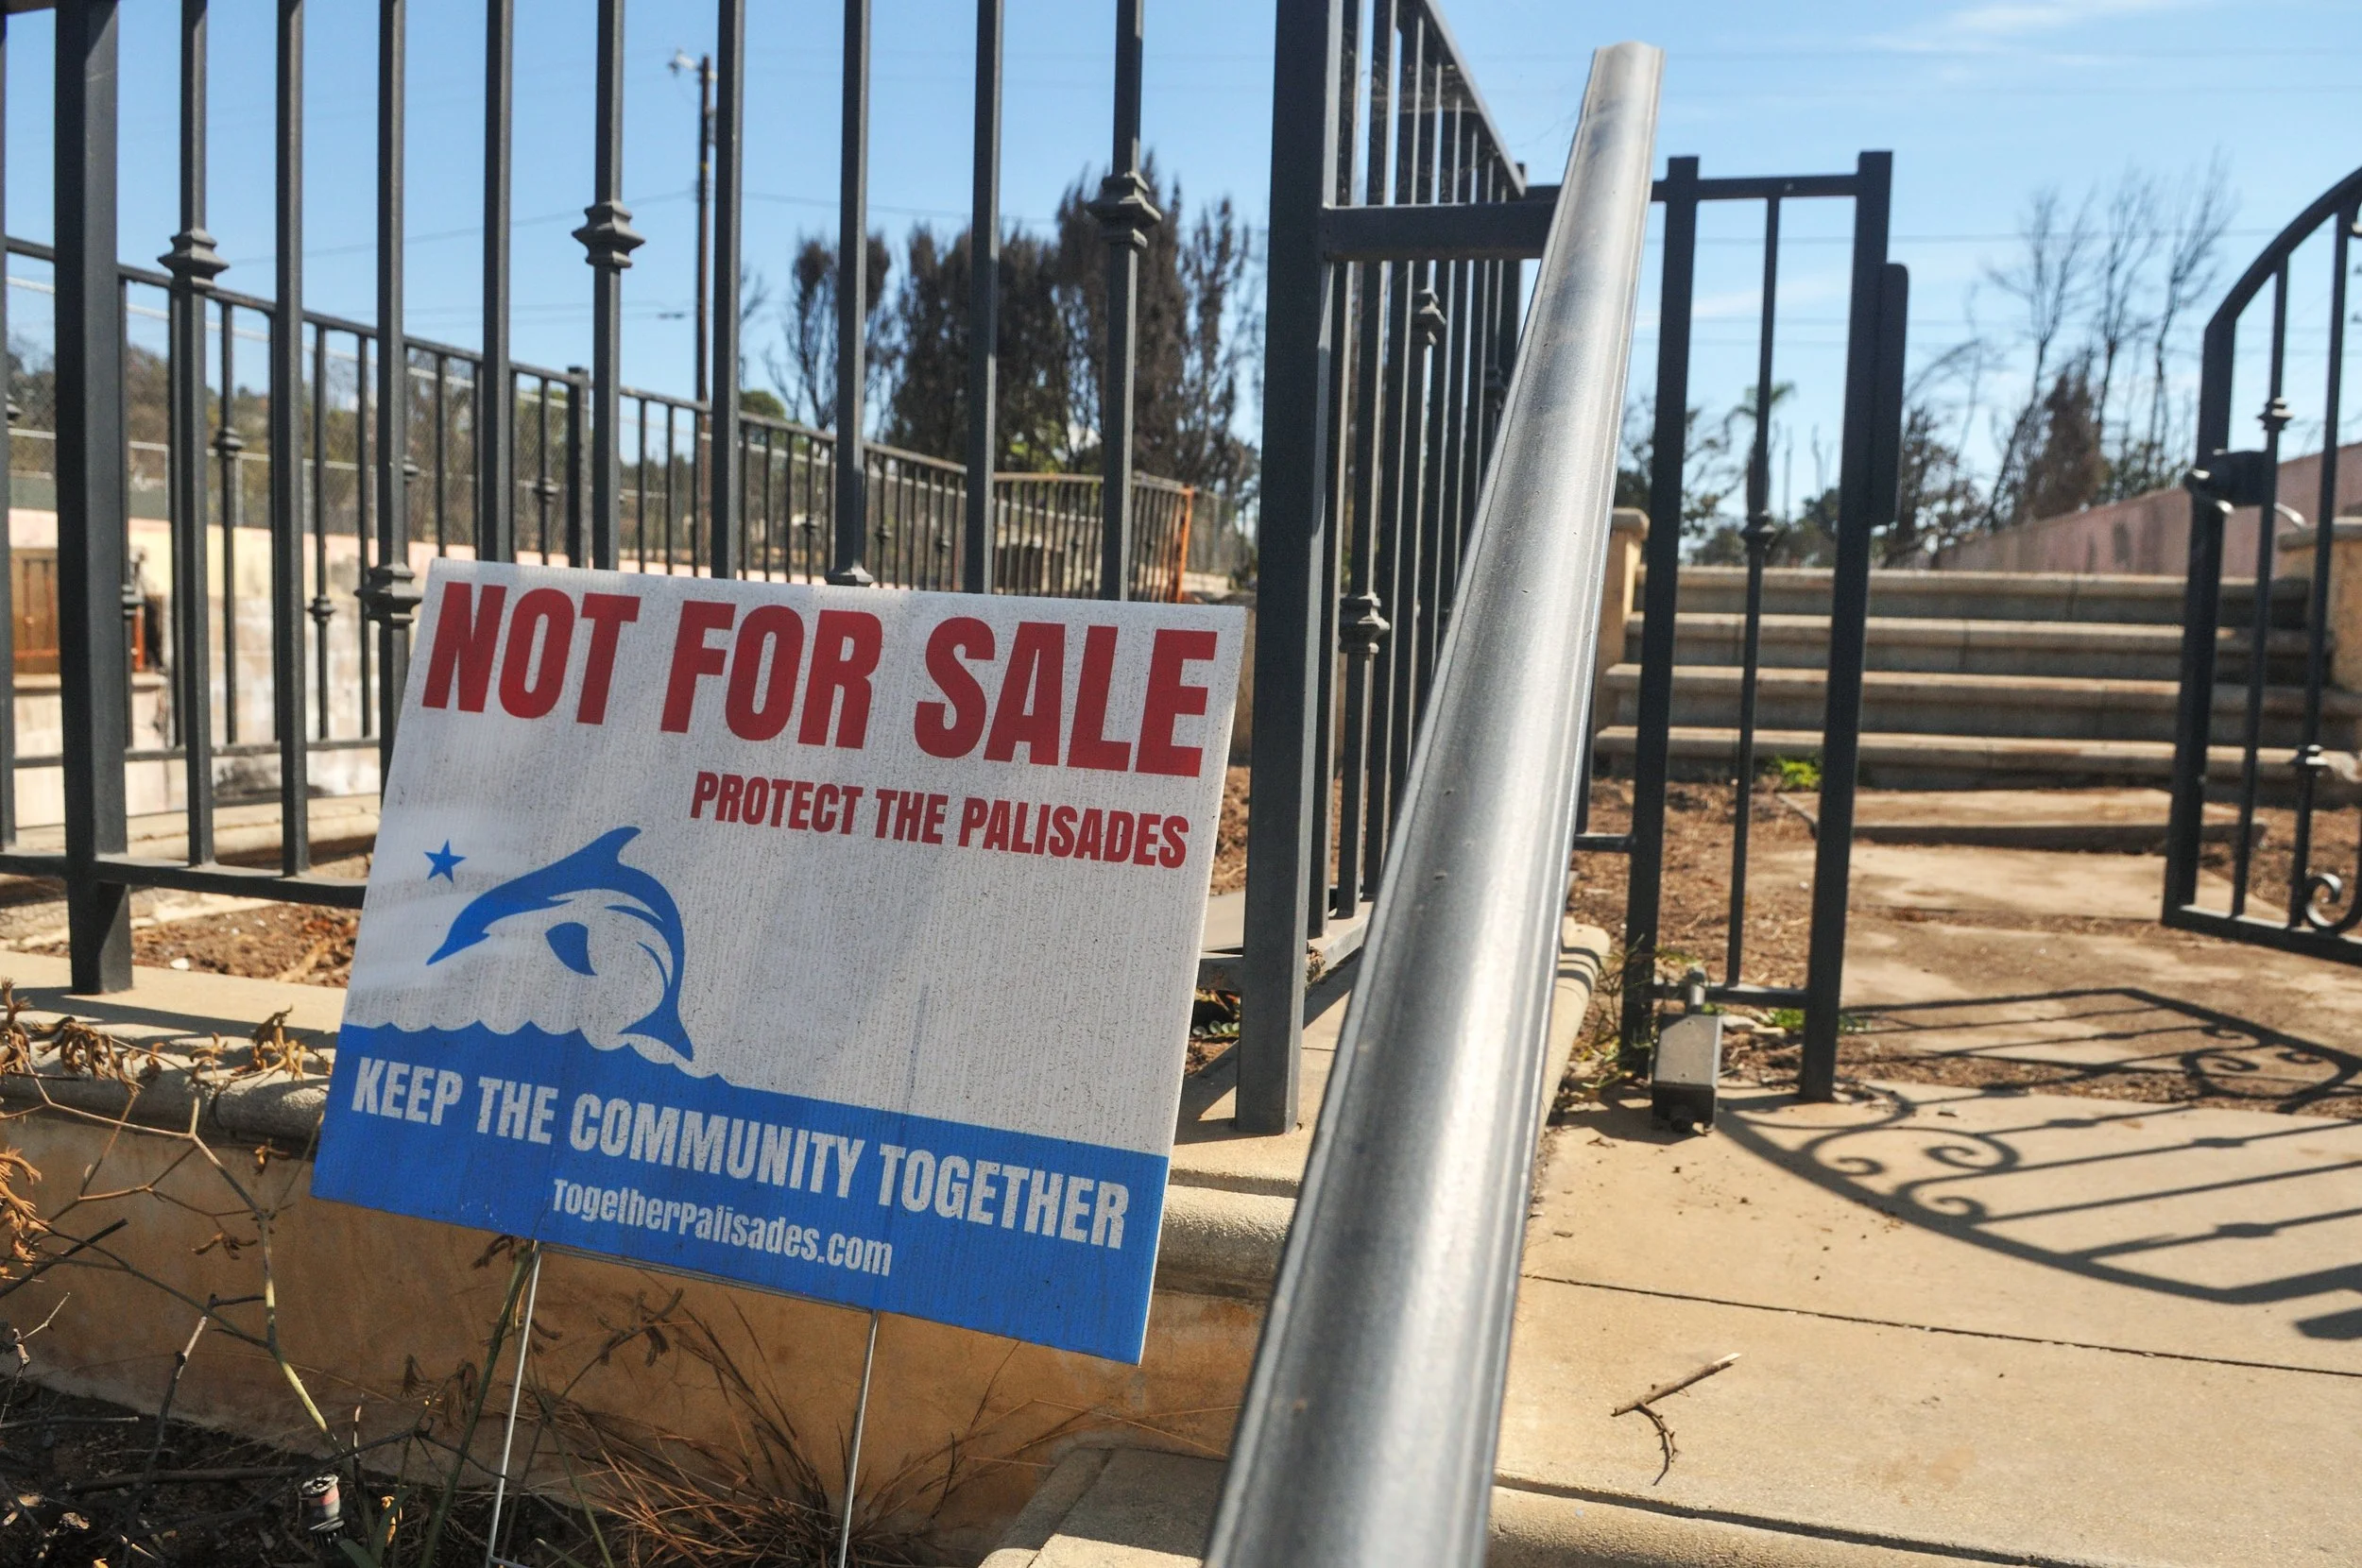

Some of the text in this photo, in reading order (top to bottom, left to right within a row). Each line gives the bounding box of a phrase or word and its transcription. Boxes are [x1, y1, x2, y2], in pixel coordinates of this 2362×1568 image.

[422, 581, 1218, 777] NOT FOR SALE
[691, 772, 1190, 870] PROTECT THE PALISADES
[351, 1057, 1129, 1250] KEEP THE COMMUNITY TOGETHER
[552, 1178, 894, 1276] TogetherPalisades.com
